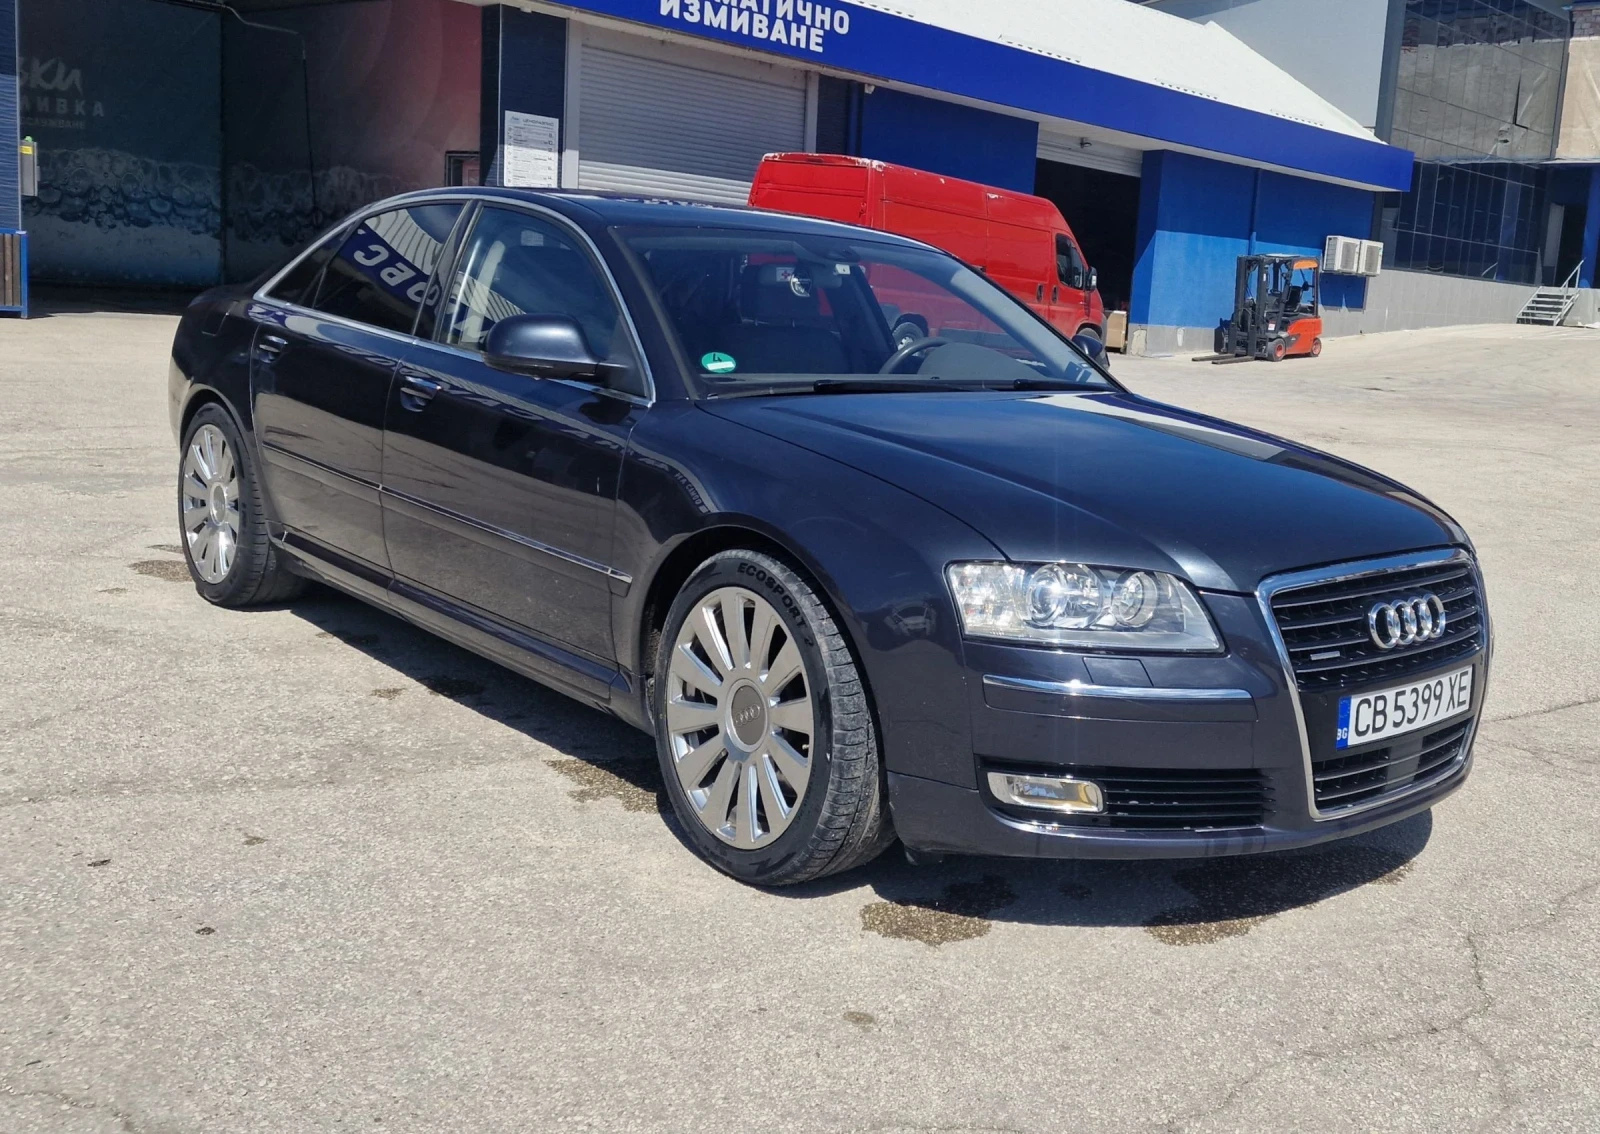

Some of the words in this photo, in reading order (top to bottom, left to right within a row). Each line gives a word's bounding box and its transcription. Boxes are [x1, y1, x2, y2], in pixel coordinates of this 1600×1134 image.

[659, 0, 824, 53] ИЗМИВАНЕ
[737, 562, 808, 630] ECOSPORT
[1354, 695, 1387, 737] CB
[1392, 679, 1444, 728] 5399
[1446, 670, 1469, 712] XE
